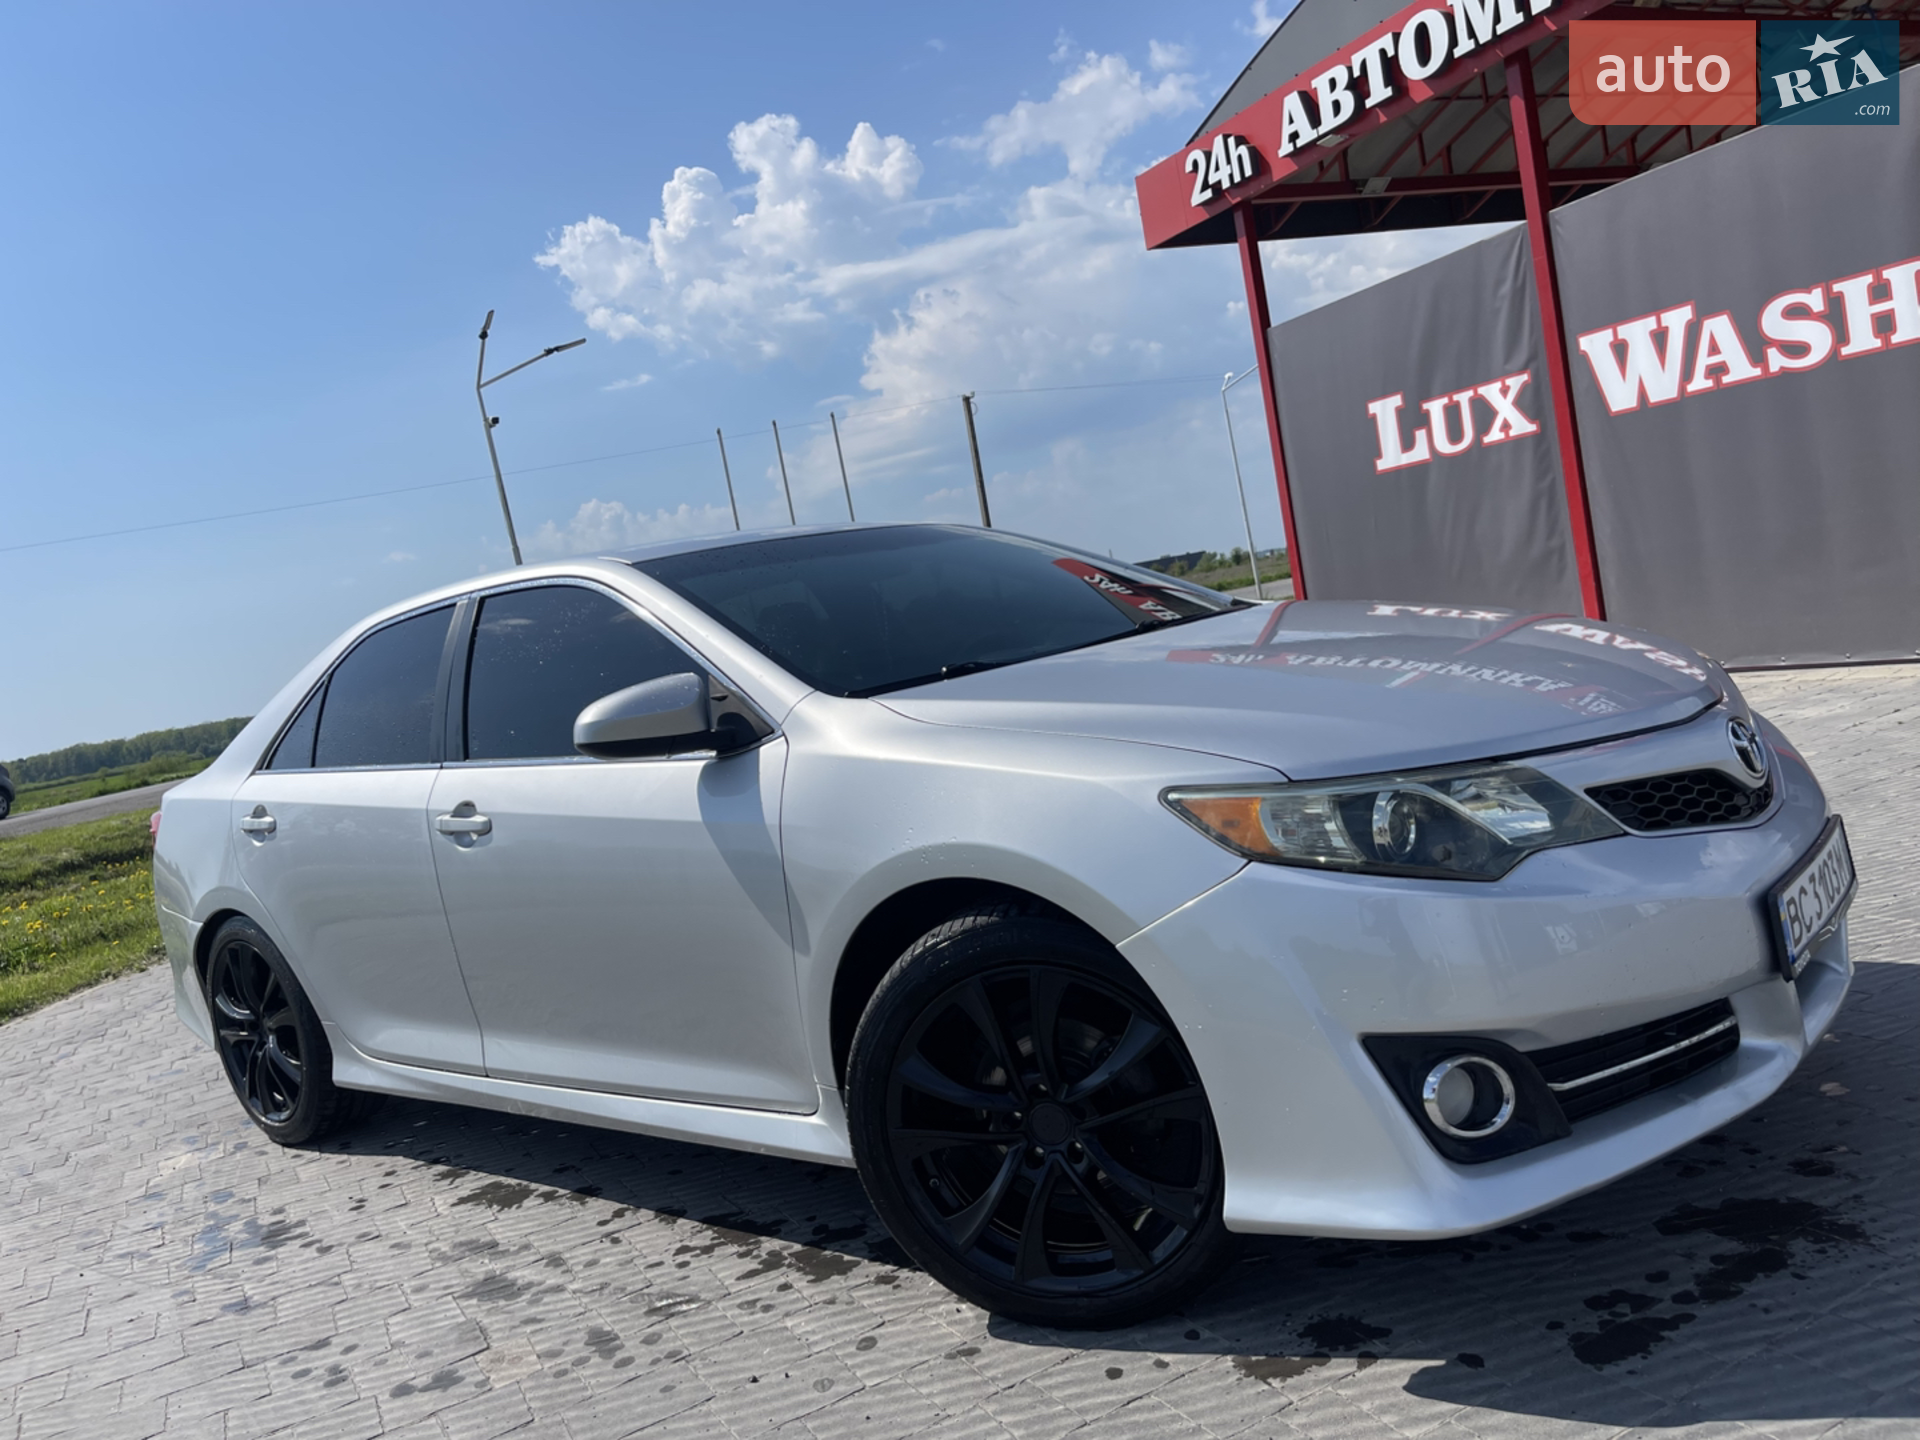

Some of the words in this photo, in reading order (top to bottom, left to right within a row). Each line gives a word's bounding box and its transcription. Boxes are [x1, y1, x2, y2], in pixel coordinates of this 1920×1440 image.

[1184, 132, 1253, 208] 24h
[1277, 0, 1552, 158] АВТОМ
[1786, 884, 1813, 949] BC
[1808, 849, 1841, 920] 3103
